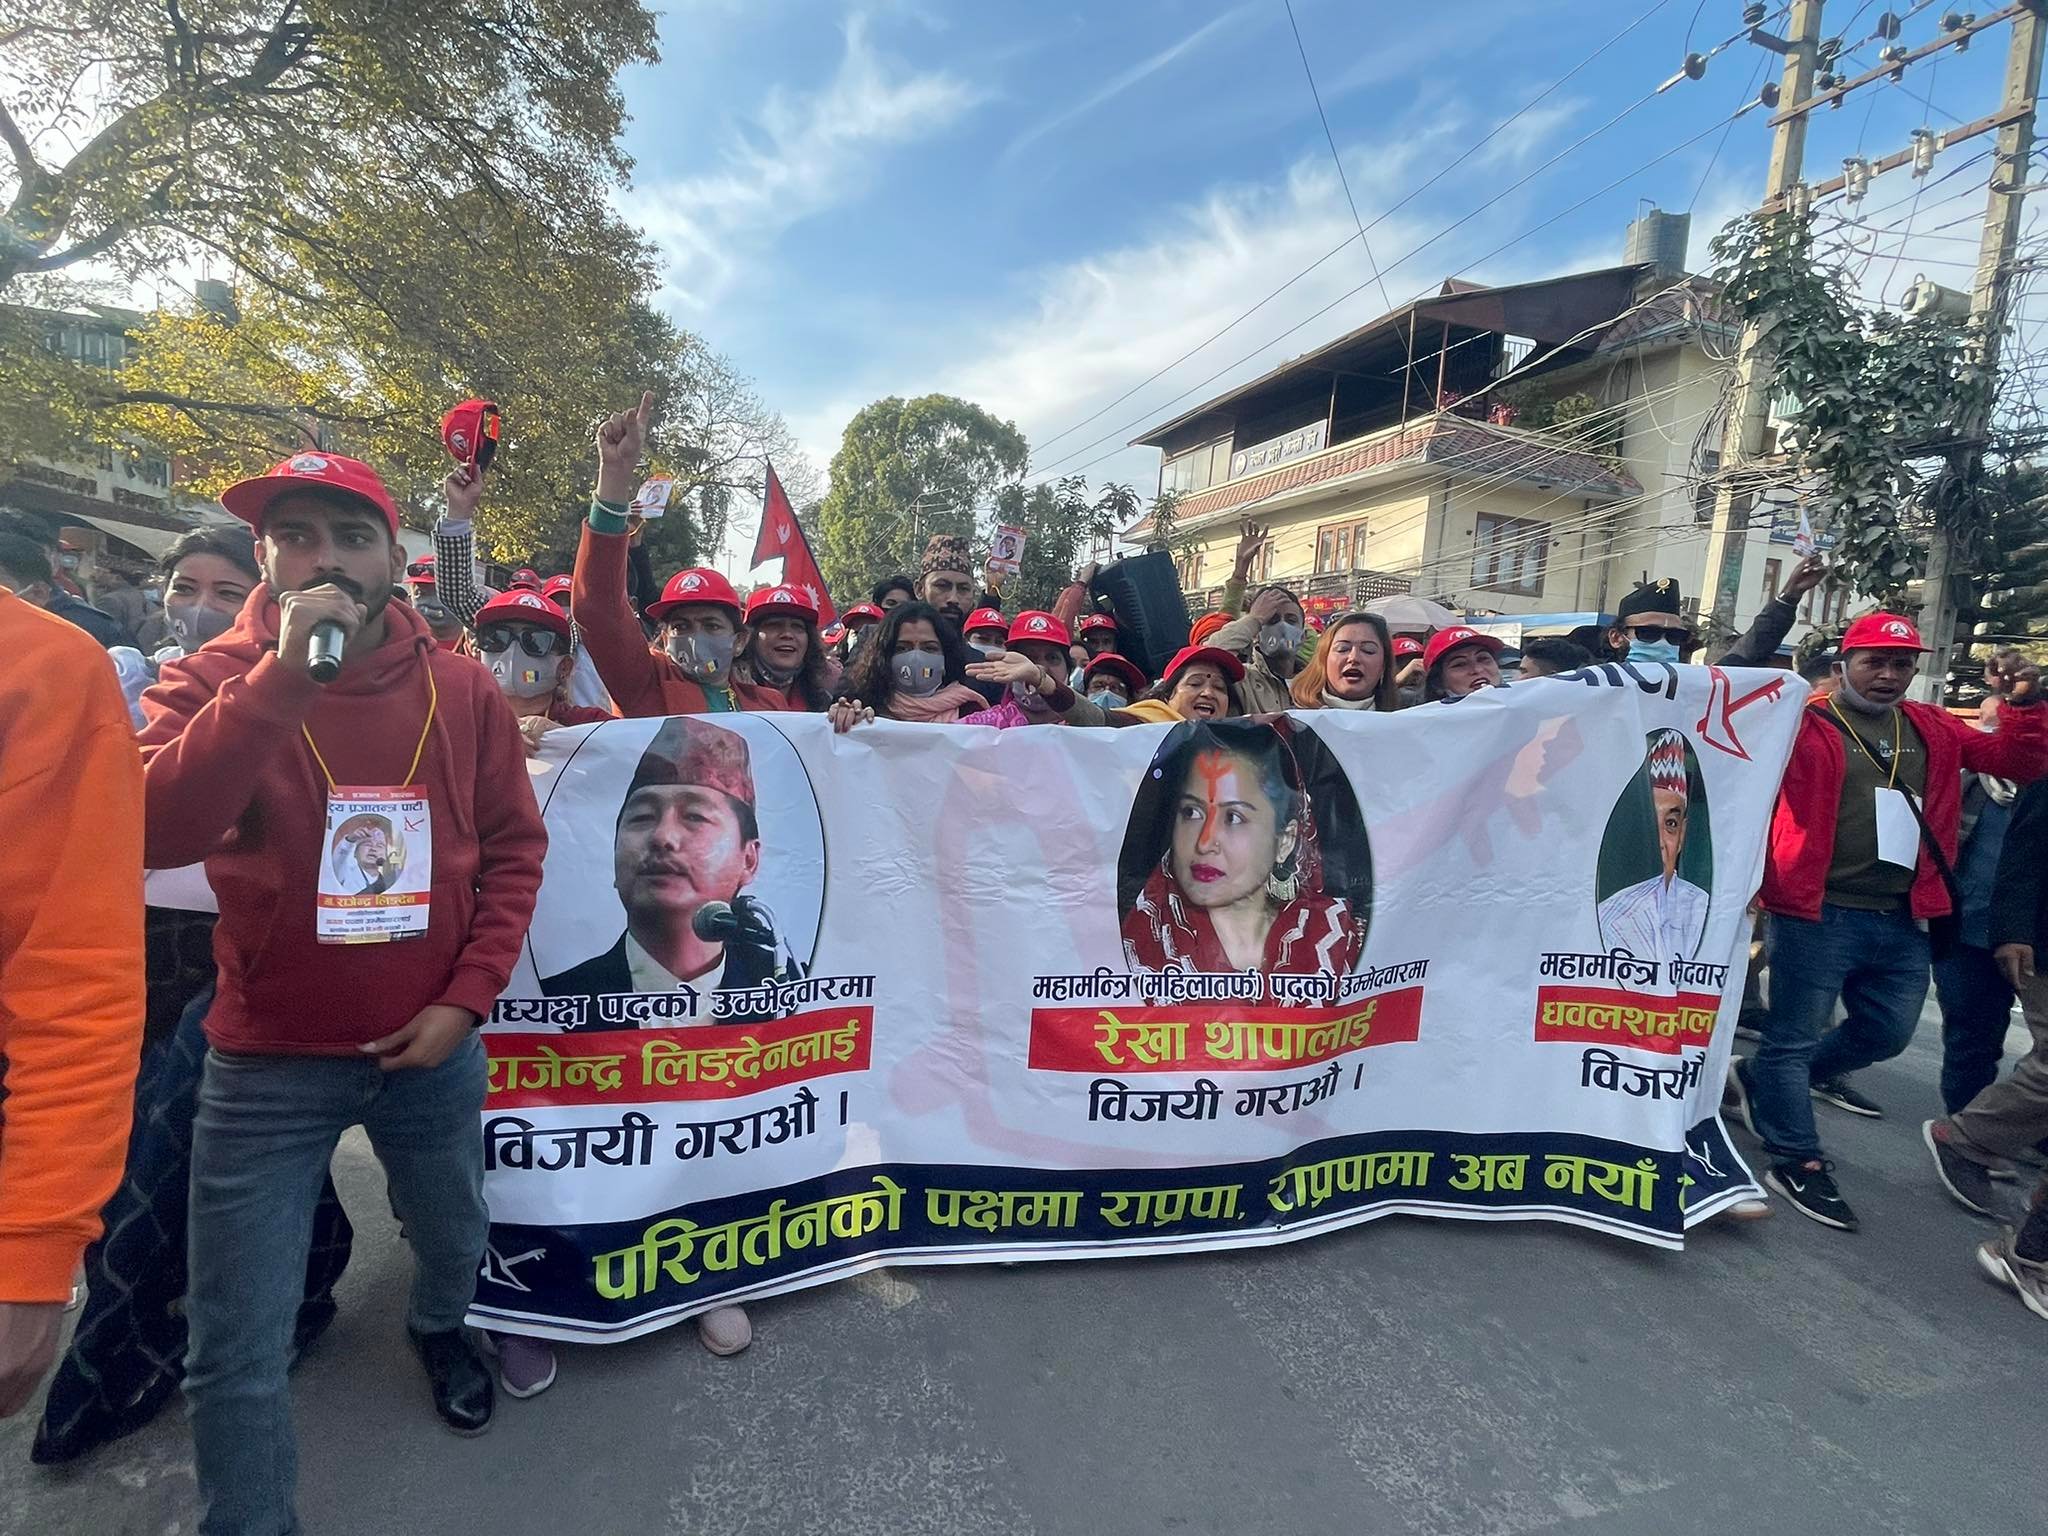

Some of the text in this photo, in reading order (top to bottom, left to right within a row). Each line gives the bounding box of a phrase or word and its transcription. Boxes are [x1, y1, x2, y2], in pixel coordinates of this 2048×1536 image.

[1032, 958, 1430, 1002] महामन्त्रि (महिलातर्फ) पदको उम्मेदवारमा
[1540, 947, 1661, 986] महामन्त्रि
[601, 983, 699, 1022] पदको
[711, 975, 876, 1017] उम्मेदवारमा
[1094, 1000, 1377, 1066] रेखा थापालाई
[487, 1045, 626, 1093] राजेन्द्र
[1087, 1077, 1223, 1122] विजयी
[484, 1111, 658, 1171] विजयी
[591, 1175, 907, 1301] परिवर्तनको
[925, 1188, 1083, 1233] पक्षमा
[1267, 1151, 1435, 1212] राप्रपामा
[1447, 1153, 1531, 1192] अब
[1544, 1156, 1661, 1212] नयाँ
